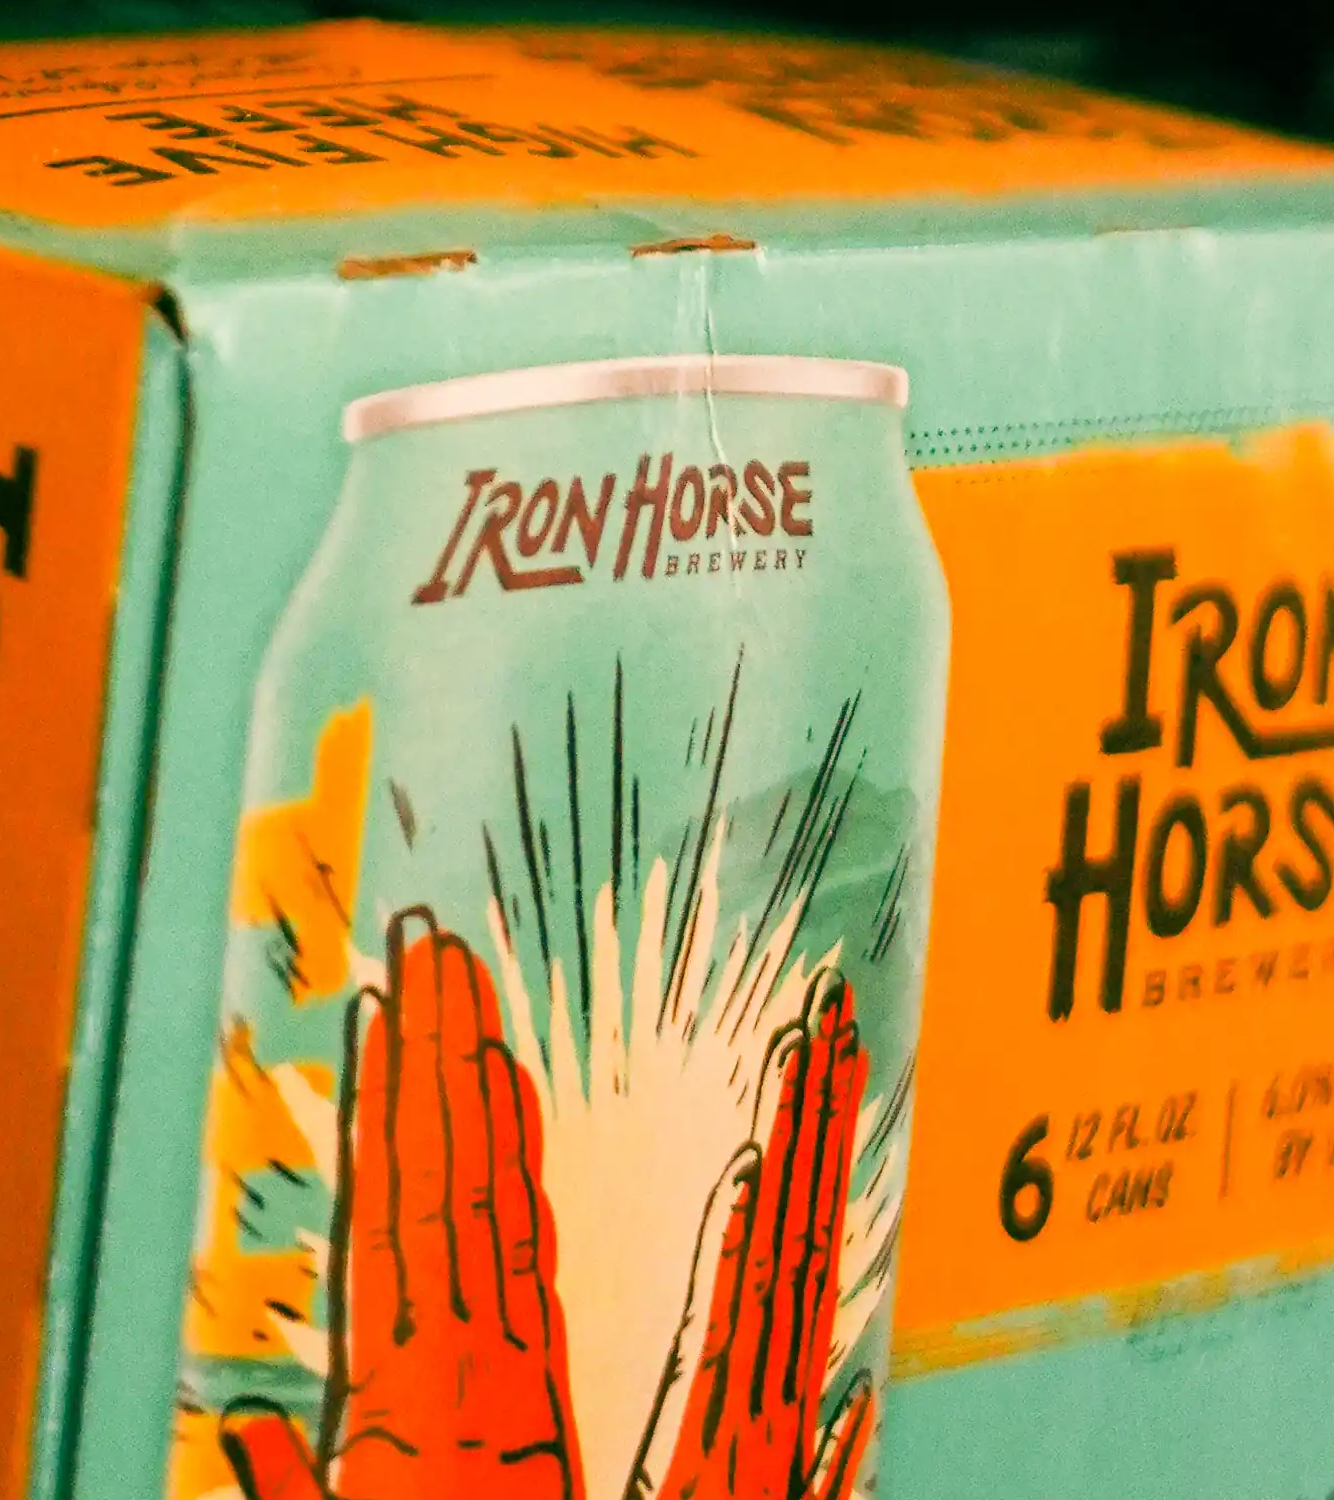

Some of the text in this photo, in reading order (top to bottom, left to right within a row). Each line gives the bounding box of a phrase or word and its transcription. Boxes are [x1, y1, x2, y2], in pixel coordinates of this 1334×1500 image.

[41, 130, 389, 188] FIVE
[372, 119, 704, 160] HIGH
[411, 451, 814, 604] IRON HORSE
[663, 547, 809, 578] BREWERY
[999, 1110, 1054, 1243] 6
[1065, 1108, 1102, 1163] 12
[1086, 1161, 1175, 1225] CANS
